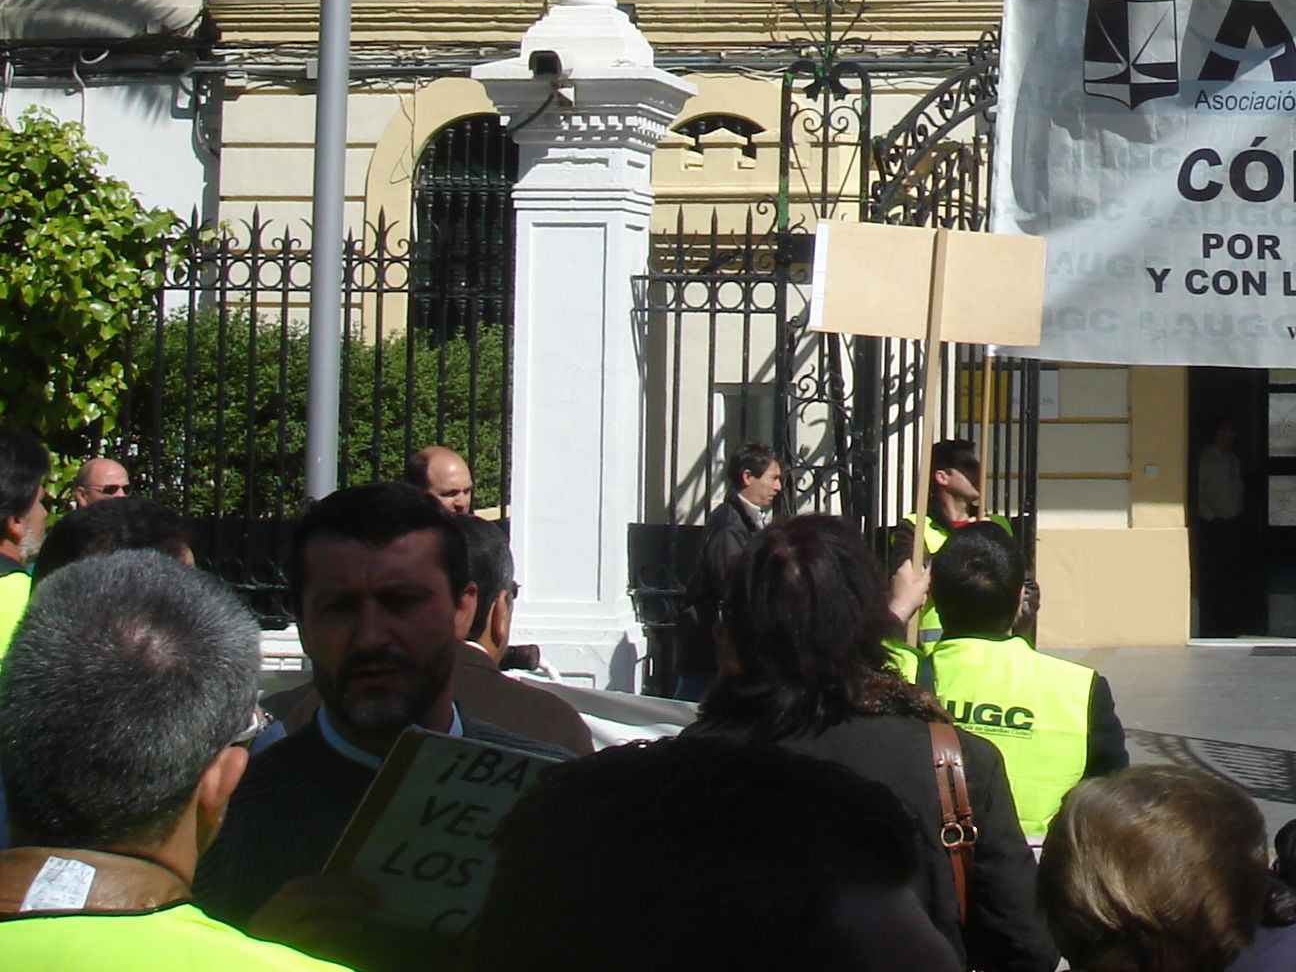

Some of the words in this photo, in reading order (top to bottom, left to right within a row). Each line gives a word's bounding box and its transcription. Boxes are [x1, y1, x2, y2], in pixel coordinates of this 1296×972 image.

[1202, 233, 1282, 261] POR
[1146, 267, 1171, 293] Y
[1184, 268, 1267, 296] CON
[377, 841, 482, 888] LOS
